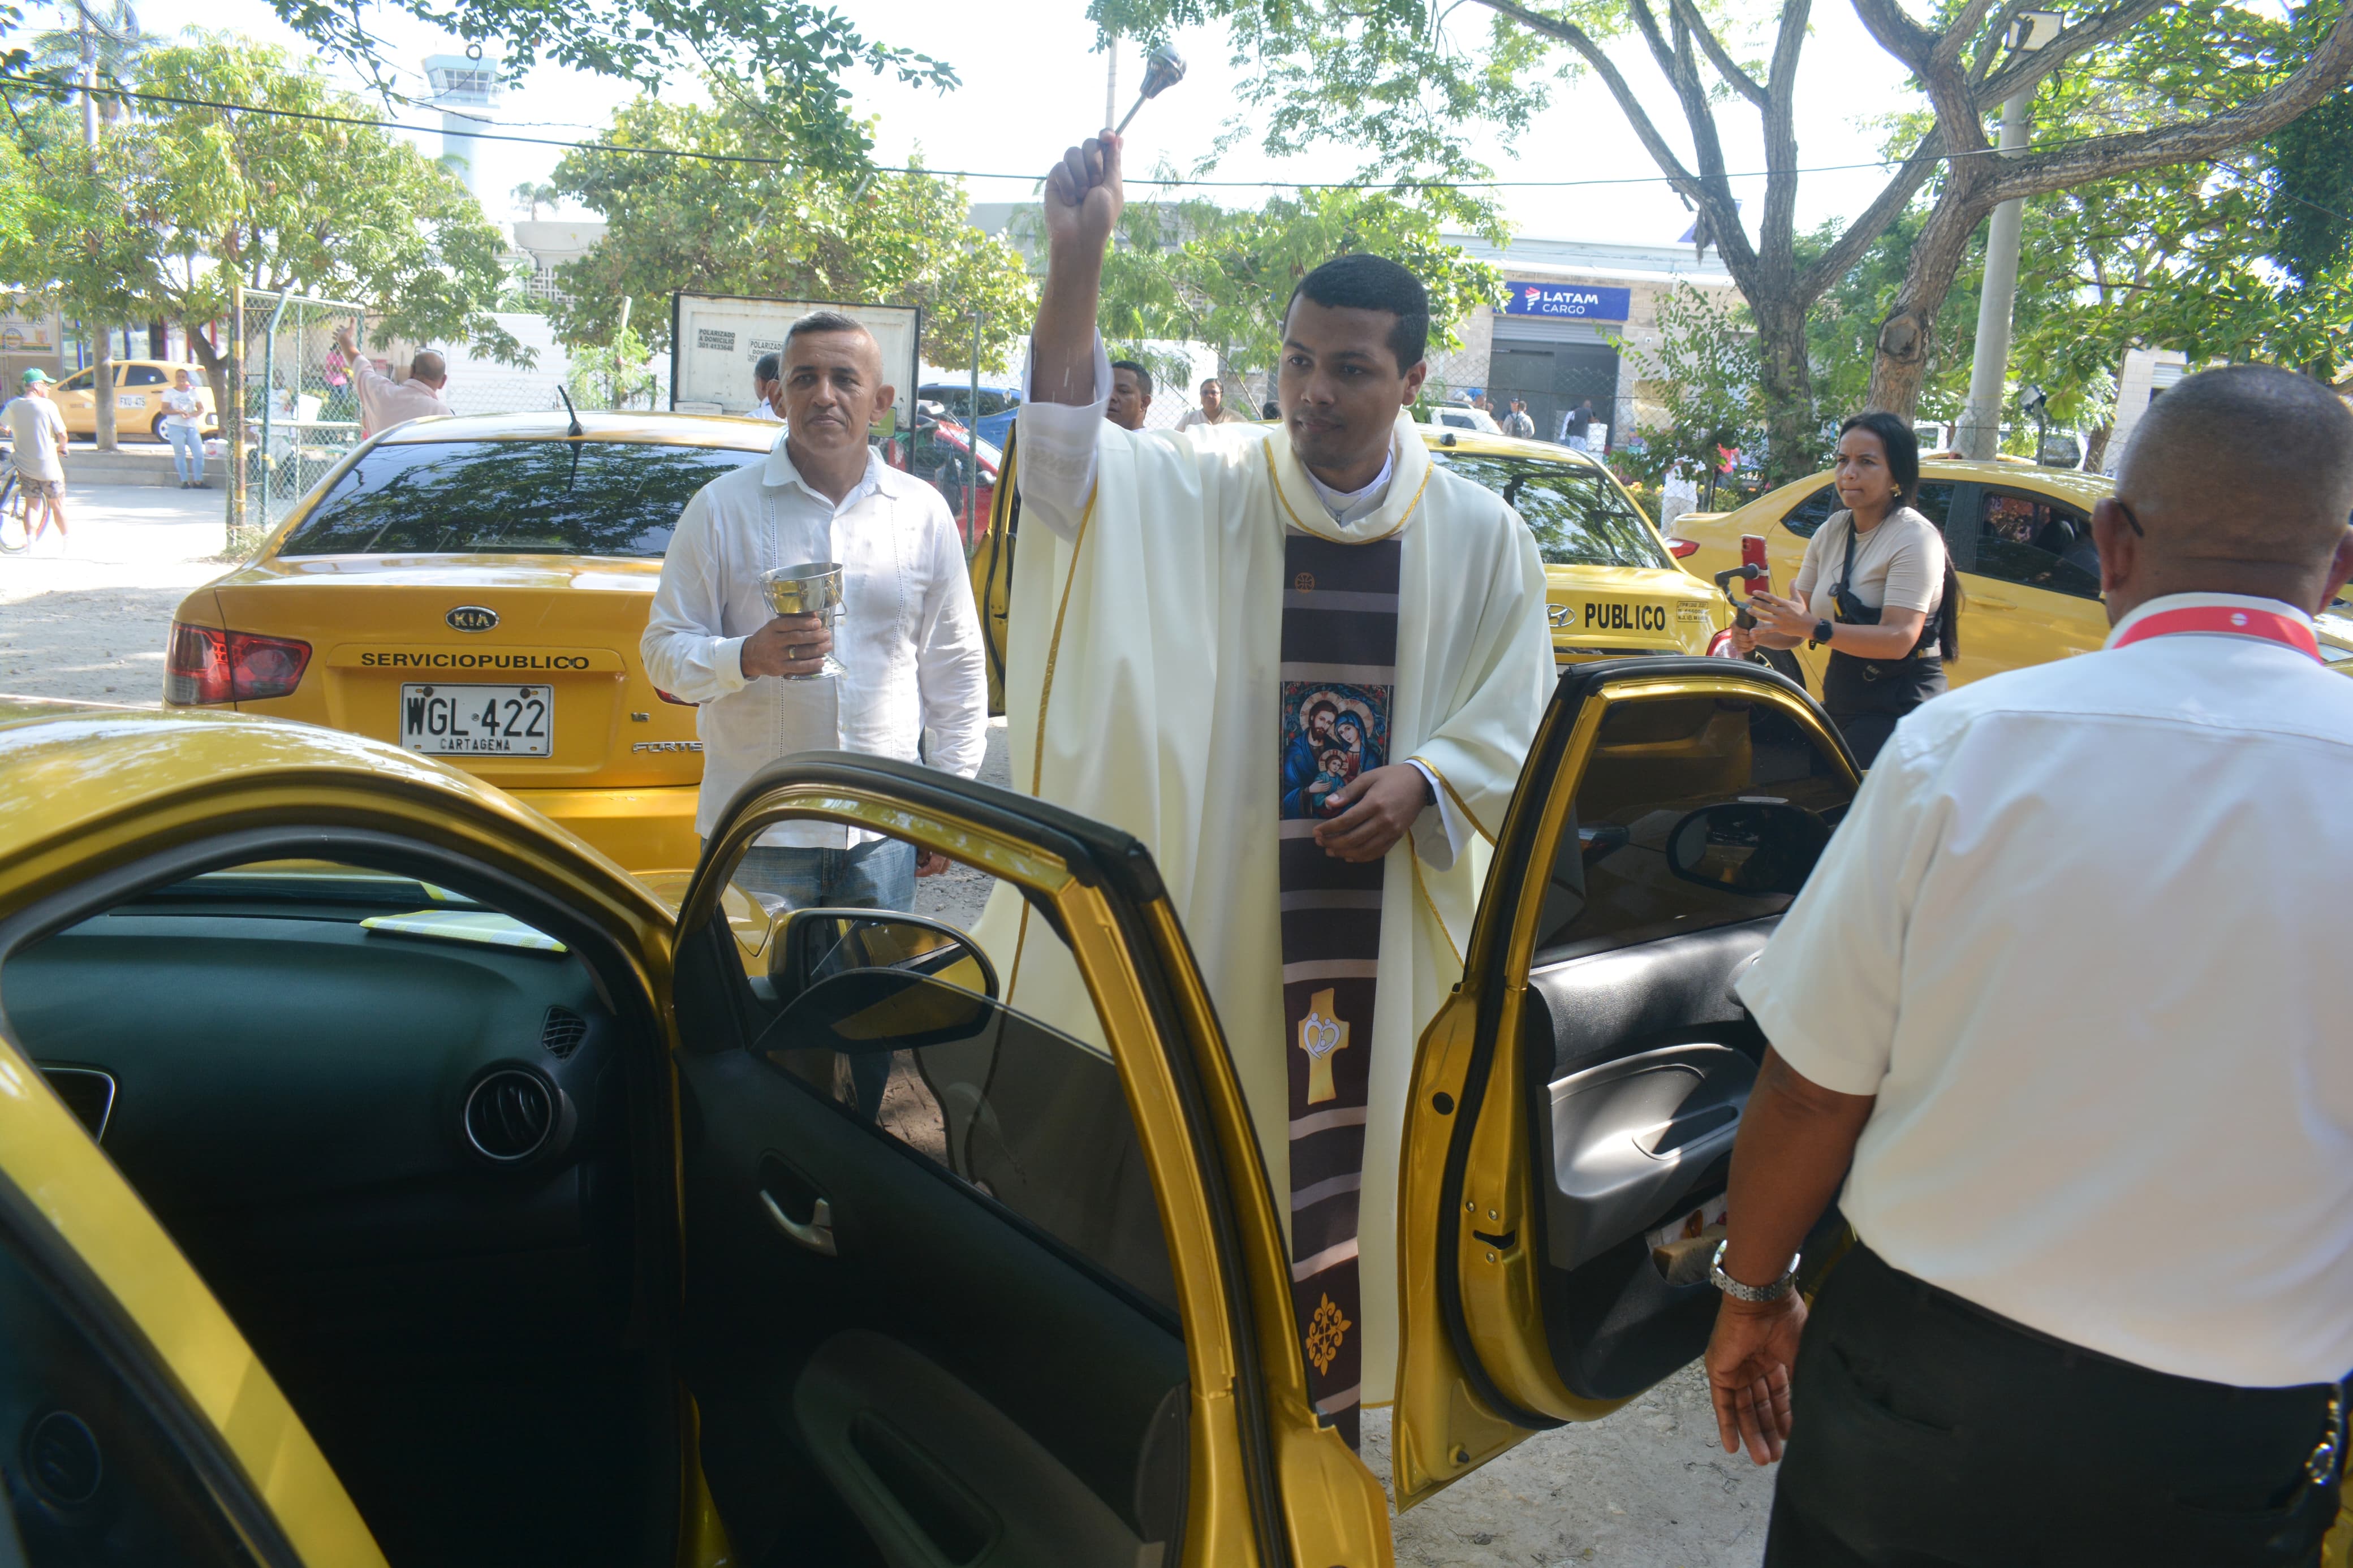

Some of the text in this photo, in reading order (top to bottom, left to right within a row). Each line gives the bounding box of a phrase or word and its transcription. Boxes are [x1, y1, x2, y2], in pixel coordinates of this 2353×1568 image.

[1544, 291, 1598, 304] LATAM
[1542, 304, 1585, 314] CARGO
[699, 329, 735, 338] POLARIZADO
[705, 336, 734, 344] DOMICILIO
[751, 341, 783, 350] POLARIZAD
[454, 612, 490, 627] KIA
[1585, 603, 1665, 630] PUBLICO
[361, 653, 589, 670] SERVICIOPUBLICO
[407, 697, 545, 737] WGL 422
[440, 738, 512, 751] CARTAGENA
[633, 741, 704, 754] FORTE
